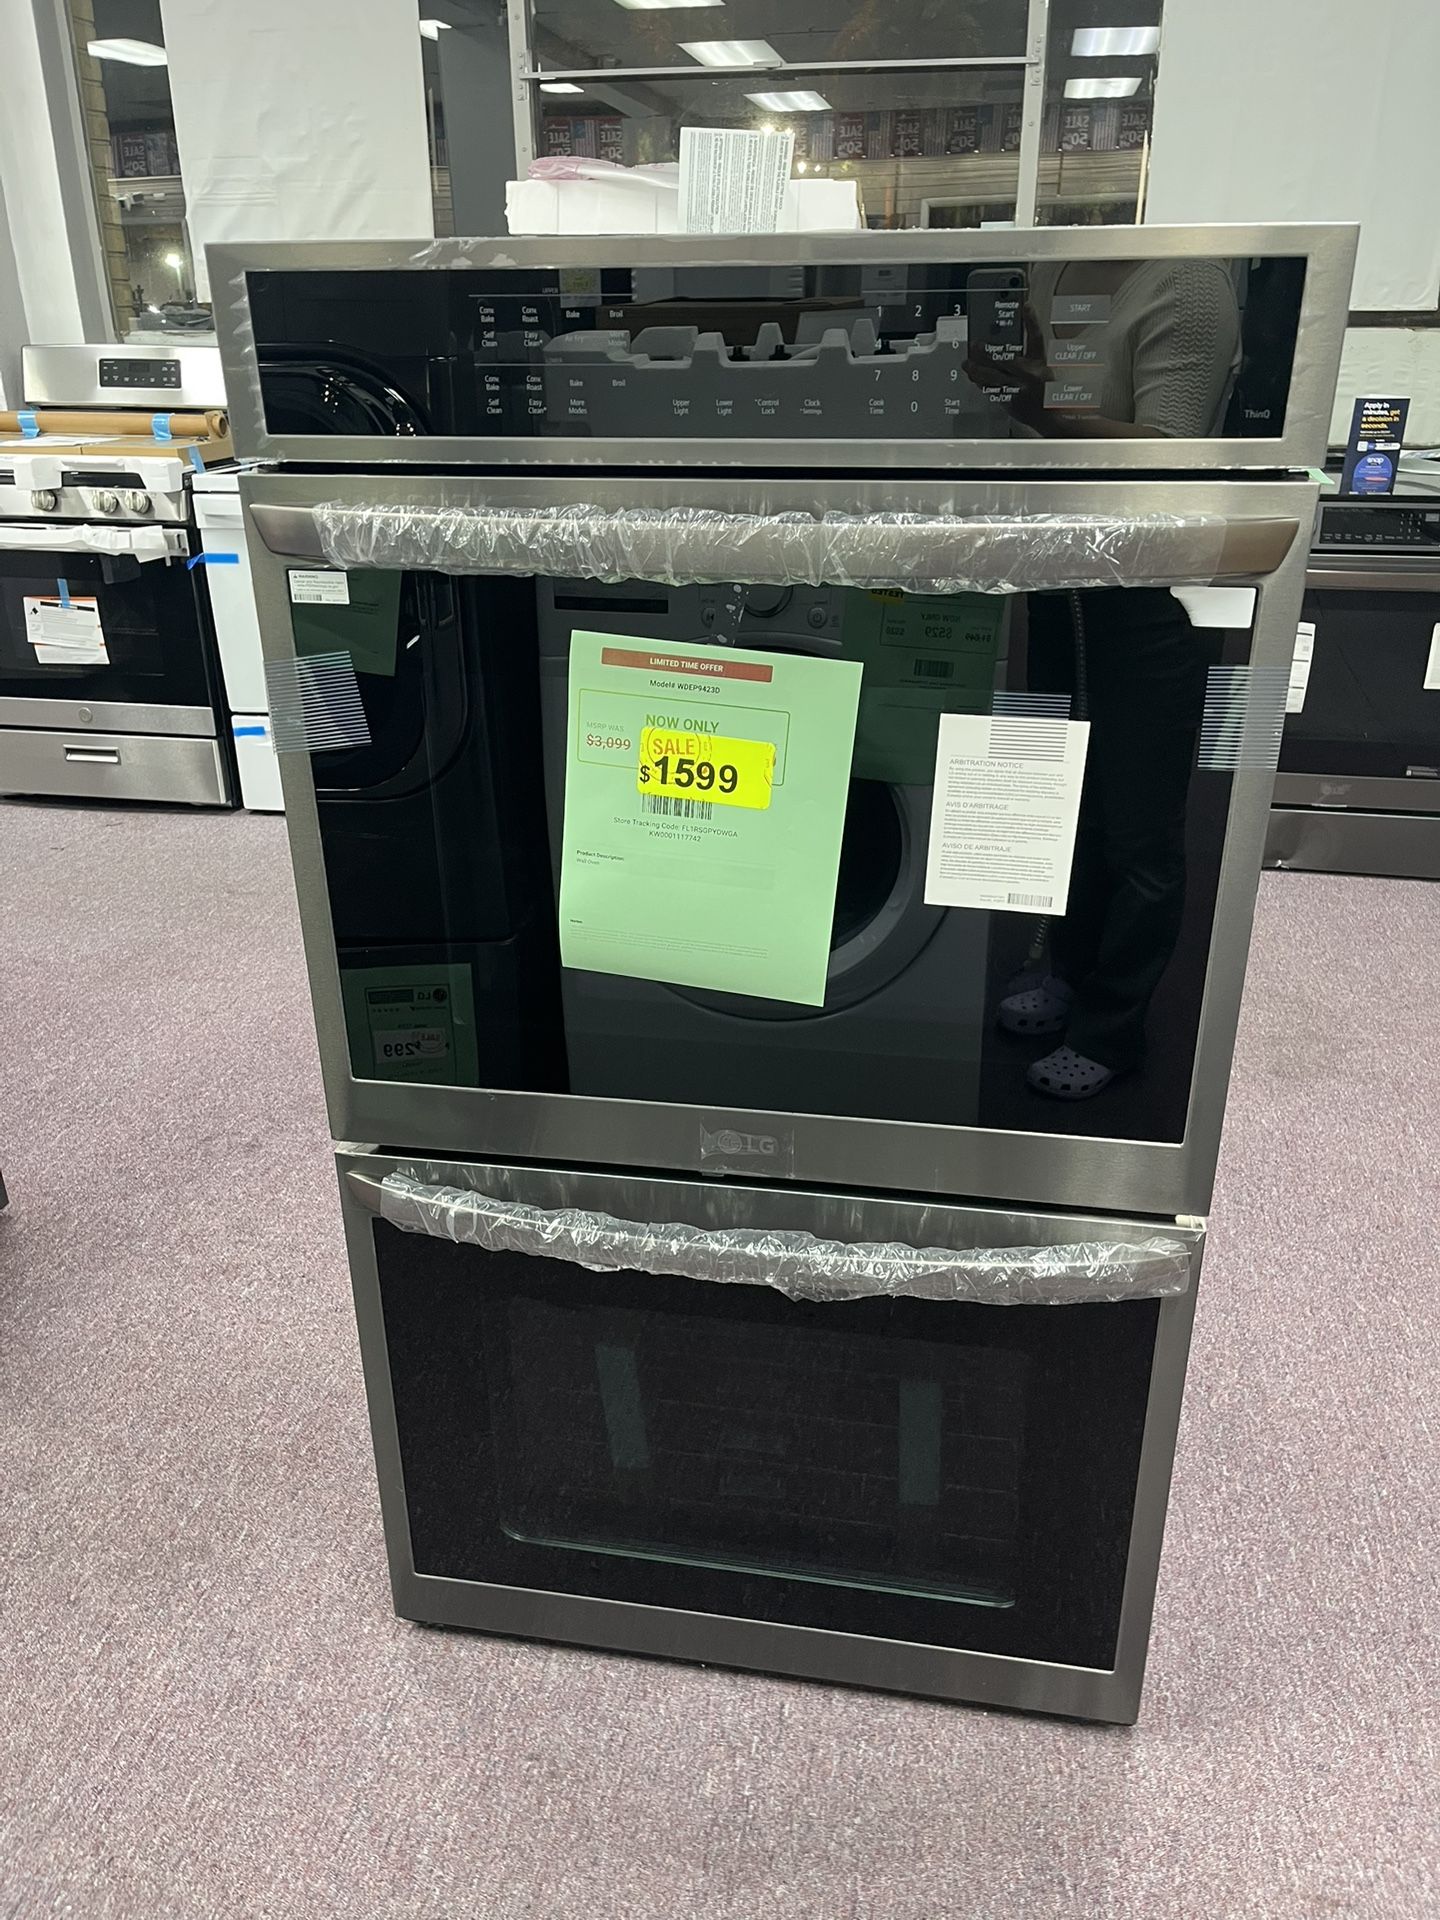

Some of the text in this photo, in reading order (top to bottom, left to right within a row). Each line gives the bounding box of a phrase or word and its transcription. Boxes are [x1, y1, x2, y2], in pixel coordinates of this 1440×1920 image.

[994, 301, 1019, 309] Remote
[1069, 303, 1091, 312] START
[566, 310, 580, 318] Bake
[609, 310, 623, 318] Broil
[877, 304, 961, 317] 1 2 3
[998, 310, 1015, 318] Start
[481, 315, 495, 323] Bake
[522, 315, 539, 323] Roast
[483, 331, 495, 339] Self
[524, 331, 539, 341] Easy
[481, 339, 498, 348] Clean
[875, 338, 882, 349] 4
[952, 338, 959, 349] 6
[985, 343, 1023, 353] Upper Timer
[1066, 342, 1087, 352] Upper
[992, 352, 1015, 361] On/Off
[1055, 351, 1076, 360] CLEAR
[1082, 351, 1097, 360] OFF
[874, 370, 957, 382] 7 8 9
[486, 383, 500, 391] Bake
[526, 383, 542, 391] Roast
[569, 379, 583, 387] Bake
[612, 379, 626, 387] Broil
[1063, 383, 1084, 392] Lower
[982, 385, 1020, 394] Lower Timer
[989, 393, 1012, 402] On/Off
[1052, 392, 1074, 401] CLEAR
[1078, 392, 1093, 400] OFF
[488, 399, 500, 407] Self
[528, 399, 542, 409] Easy
[570, 399, 585, 407] More
[672, 399, 690, 408] Upper
[716, 399, 733, 407] Lower
[804, 399, 820, 407] Clock
[869, 399, 884, 407] Cook
[911, 402, 918, 413] 0
[945, 399, 960, 407] Start
[486, 406, 502, 414] Clean
[568, 407, 587, 415] Modes
[674, 407, 689, 416] Light
[717, 407, 732, 416] Light
[761, 407, 775, 415] Lock
[869, 407, 884, 415] Time
[945, 407, 960, 415] Time
[1244, 409, 1270, 419] ThinQ
[649, 657, 724, 672] LIMITED TIME OFFER
[649, 680, 720, 694] Model# WDEP9423D
[608, 724, 624, 732] WAS
[645, 714, 720, 733] NOW ONLY
[586, 733, 632, 750] $3,099
[652, 737, 696, 756] SALE
[950, 758, 1024, 769] ARBITRATION NOTICE
[962, 802, 1009, 810] D'ARBITRAGE
[613, 816, 632, 826] Store
[632, 818, 660, 831] Tracking
[974, 844, 1012, 852] ARBITRAJE
[746, 1135, 776, 1154] LG
